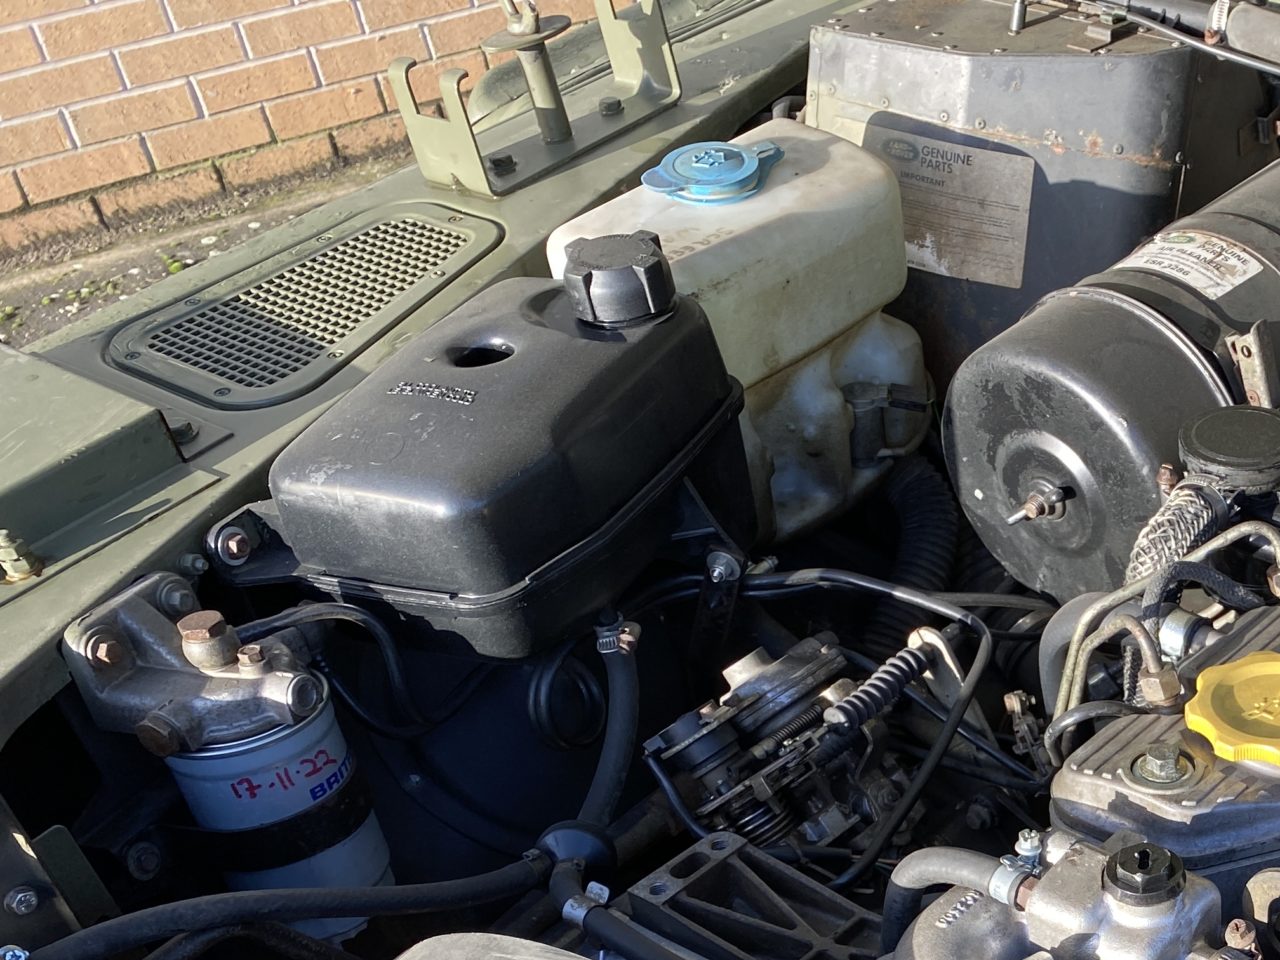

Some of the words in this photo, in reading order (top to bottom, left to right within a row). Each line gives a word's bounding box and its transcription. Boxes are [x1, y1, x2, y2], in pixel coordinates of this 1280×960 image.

[921, 145, 973, 166] GENUINE
[920, 156, 953, 174] PARTS
[900, 170, 946, 188] IMPORTANT
[1175, 247, 1223, 273] CLEANER
[1197, 244, 1231, 262] PARTS
[1205, 240, 1249, 266] GENUINE
[1163, 261, 1191, 276] 3286
